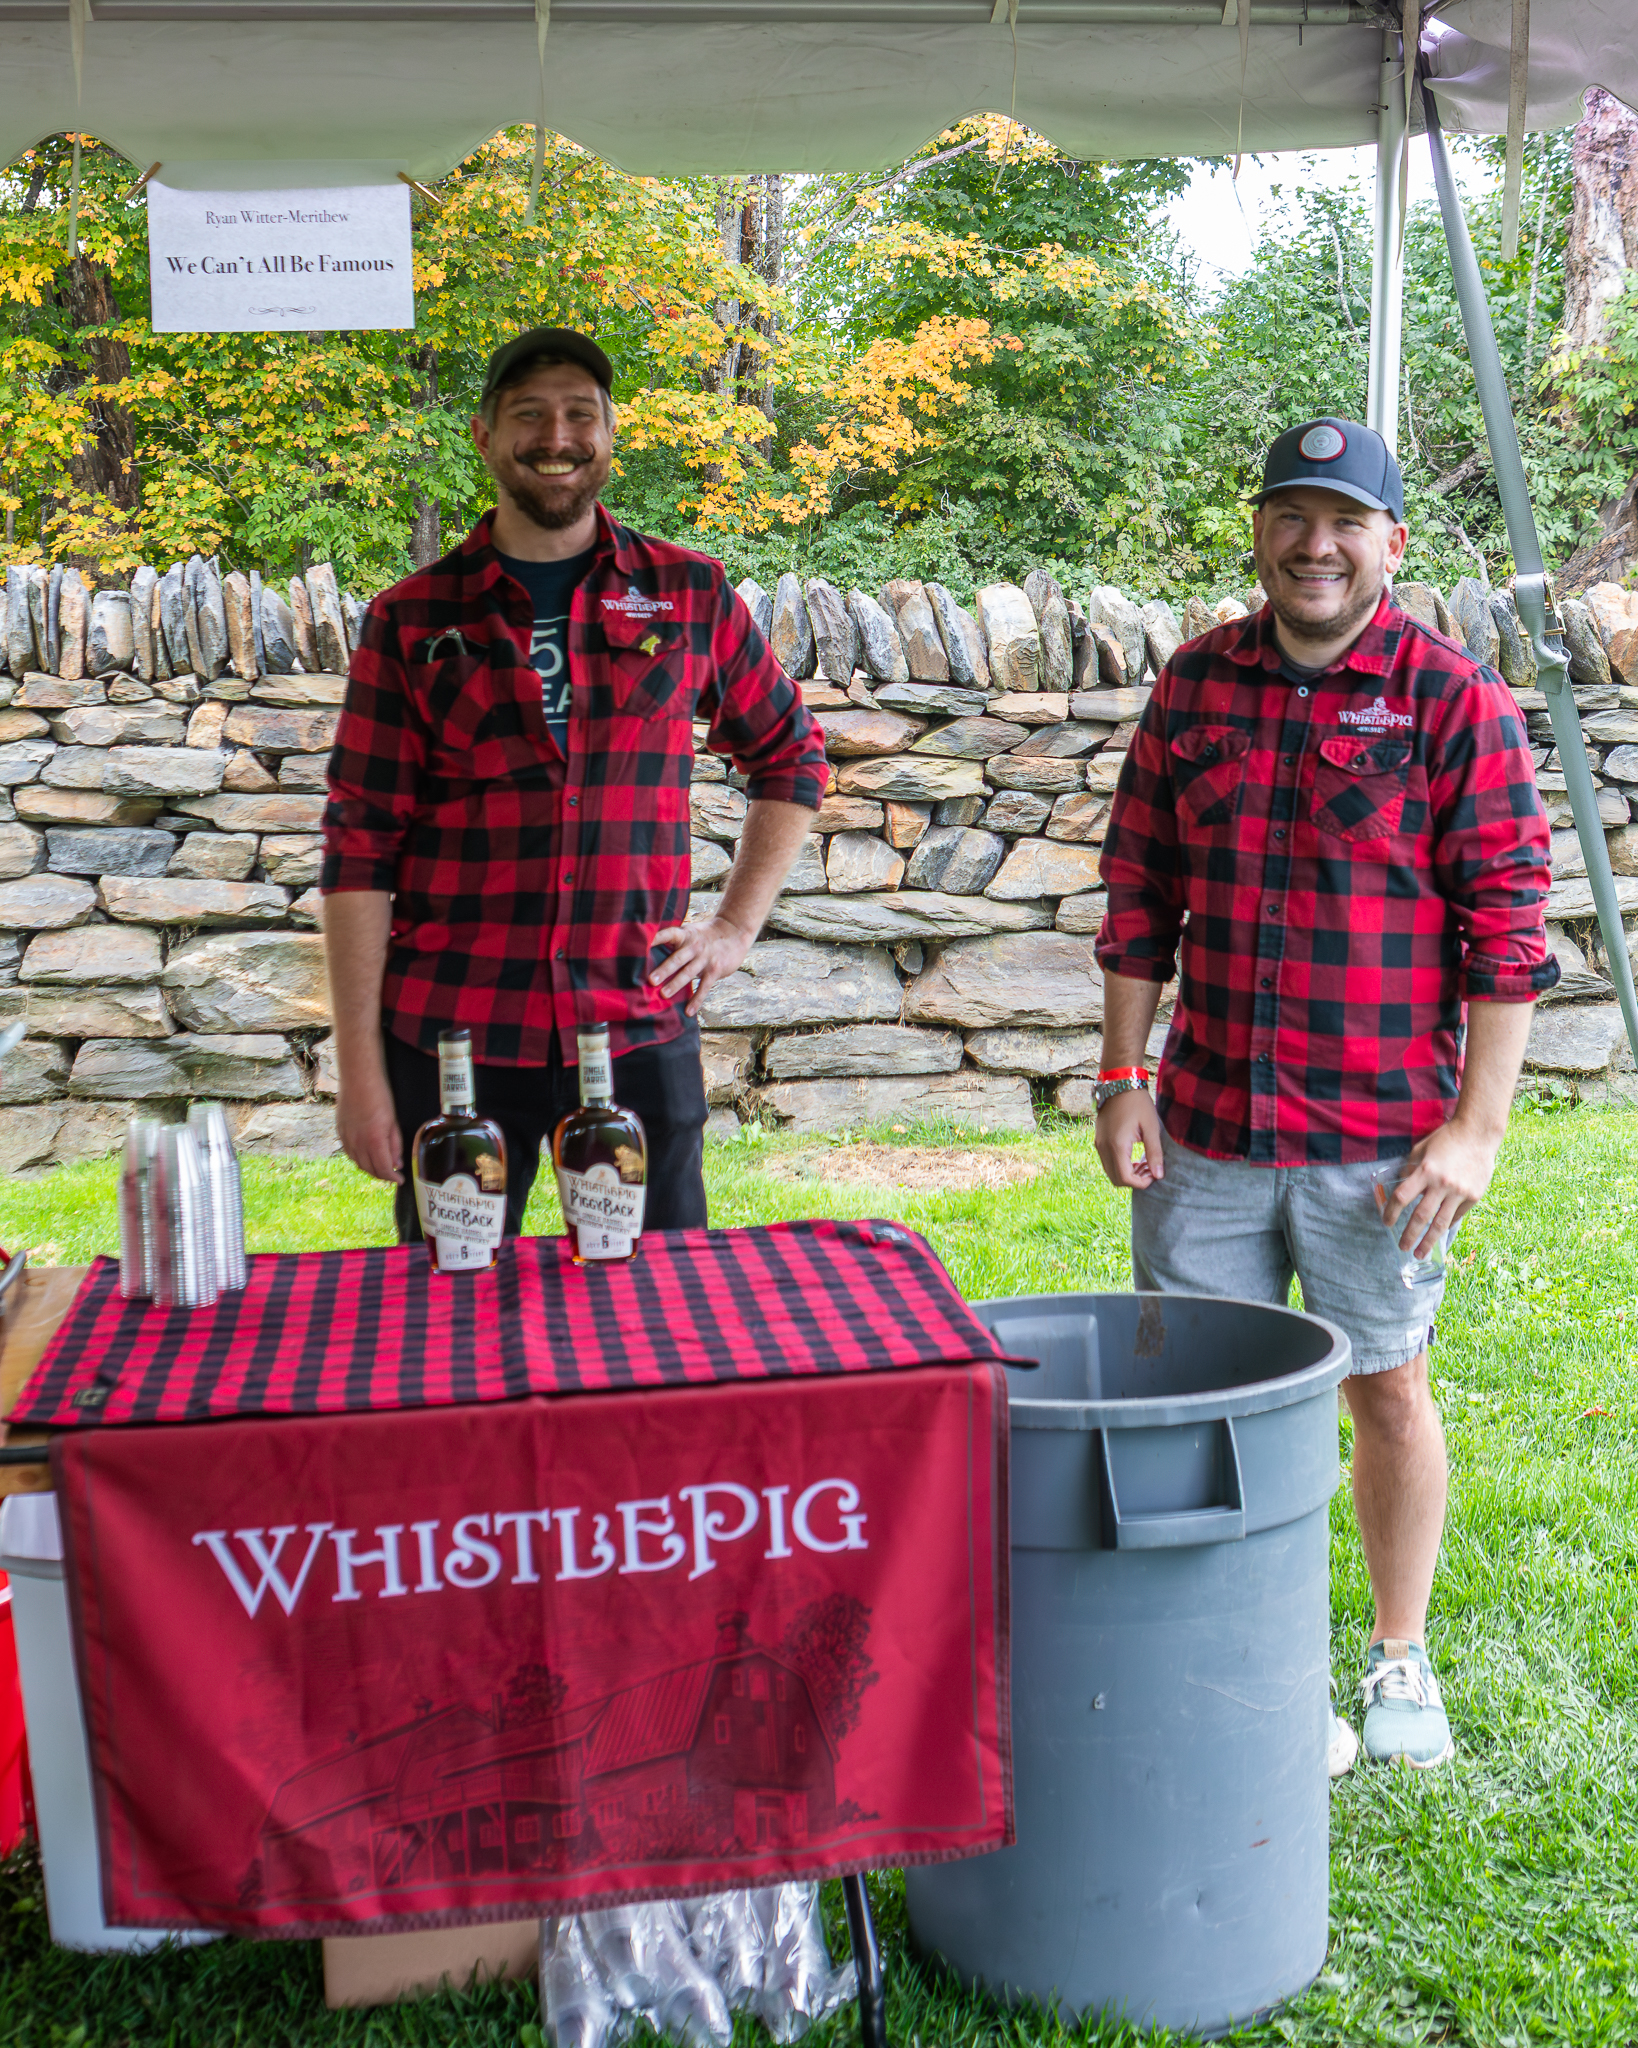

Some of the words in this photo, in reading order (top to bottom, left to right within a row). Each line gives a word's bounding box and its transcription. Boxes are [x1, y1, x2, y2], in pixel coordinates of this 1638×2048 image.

[205, 210, 238, 228] Ryan
[240, 209, 350, 225] Witter-Merithew
[165, 256, 198, 275] We
[258, 255, 285, 274] All
[290, 255, 314, 273] Be
[318, 254, 394, 273] Famous
[191, 1478, 870, 1620] WHISTLEPIG
